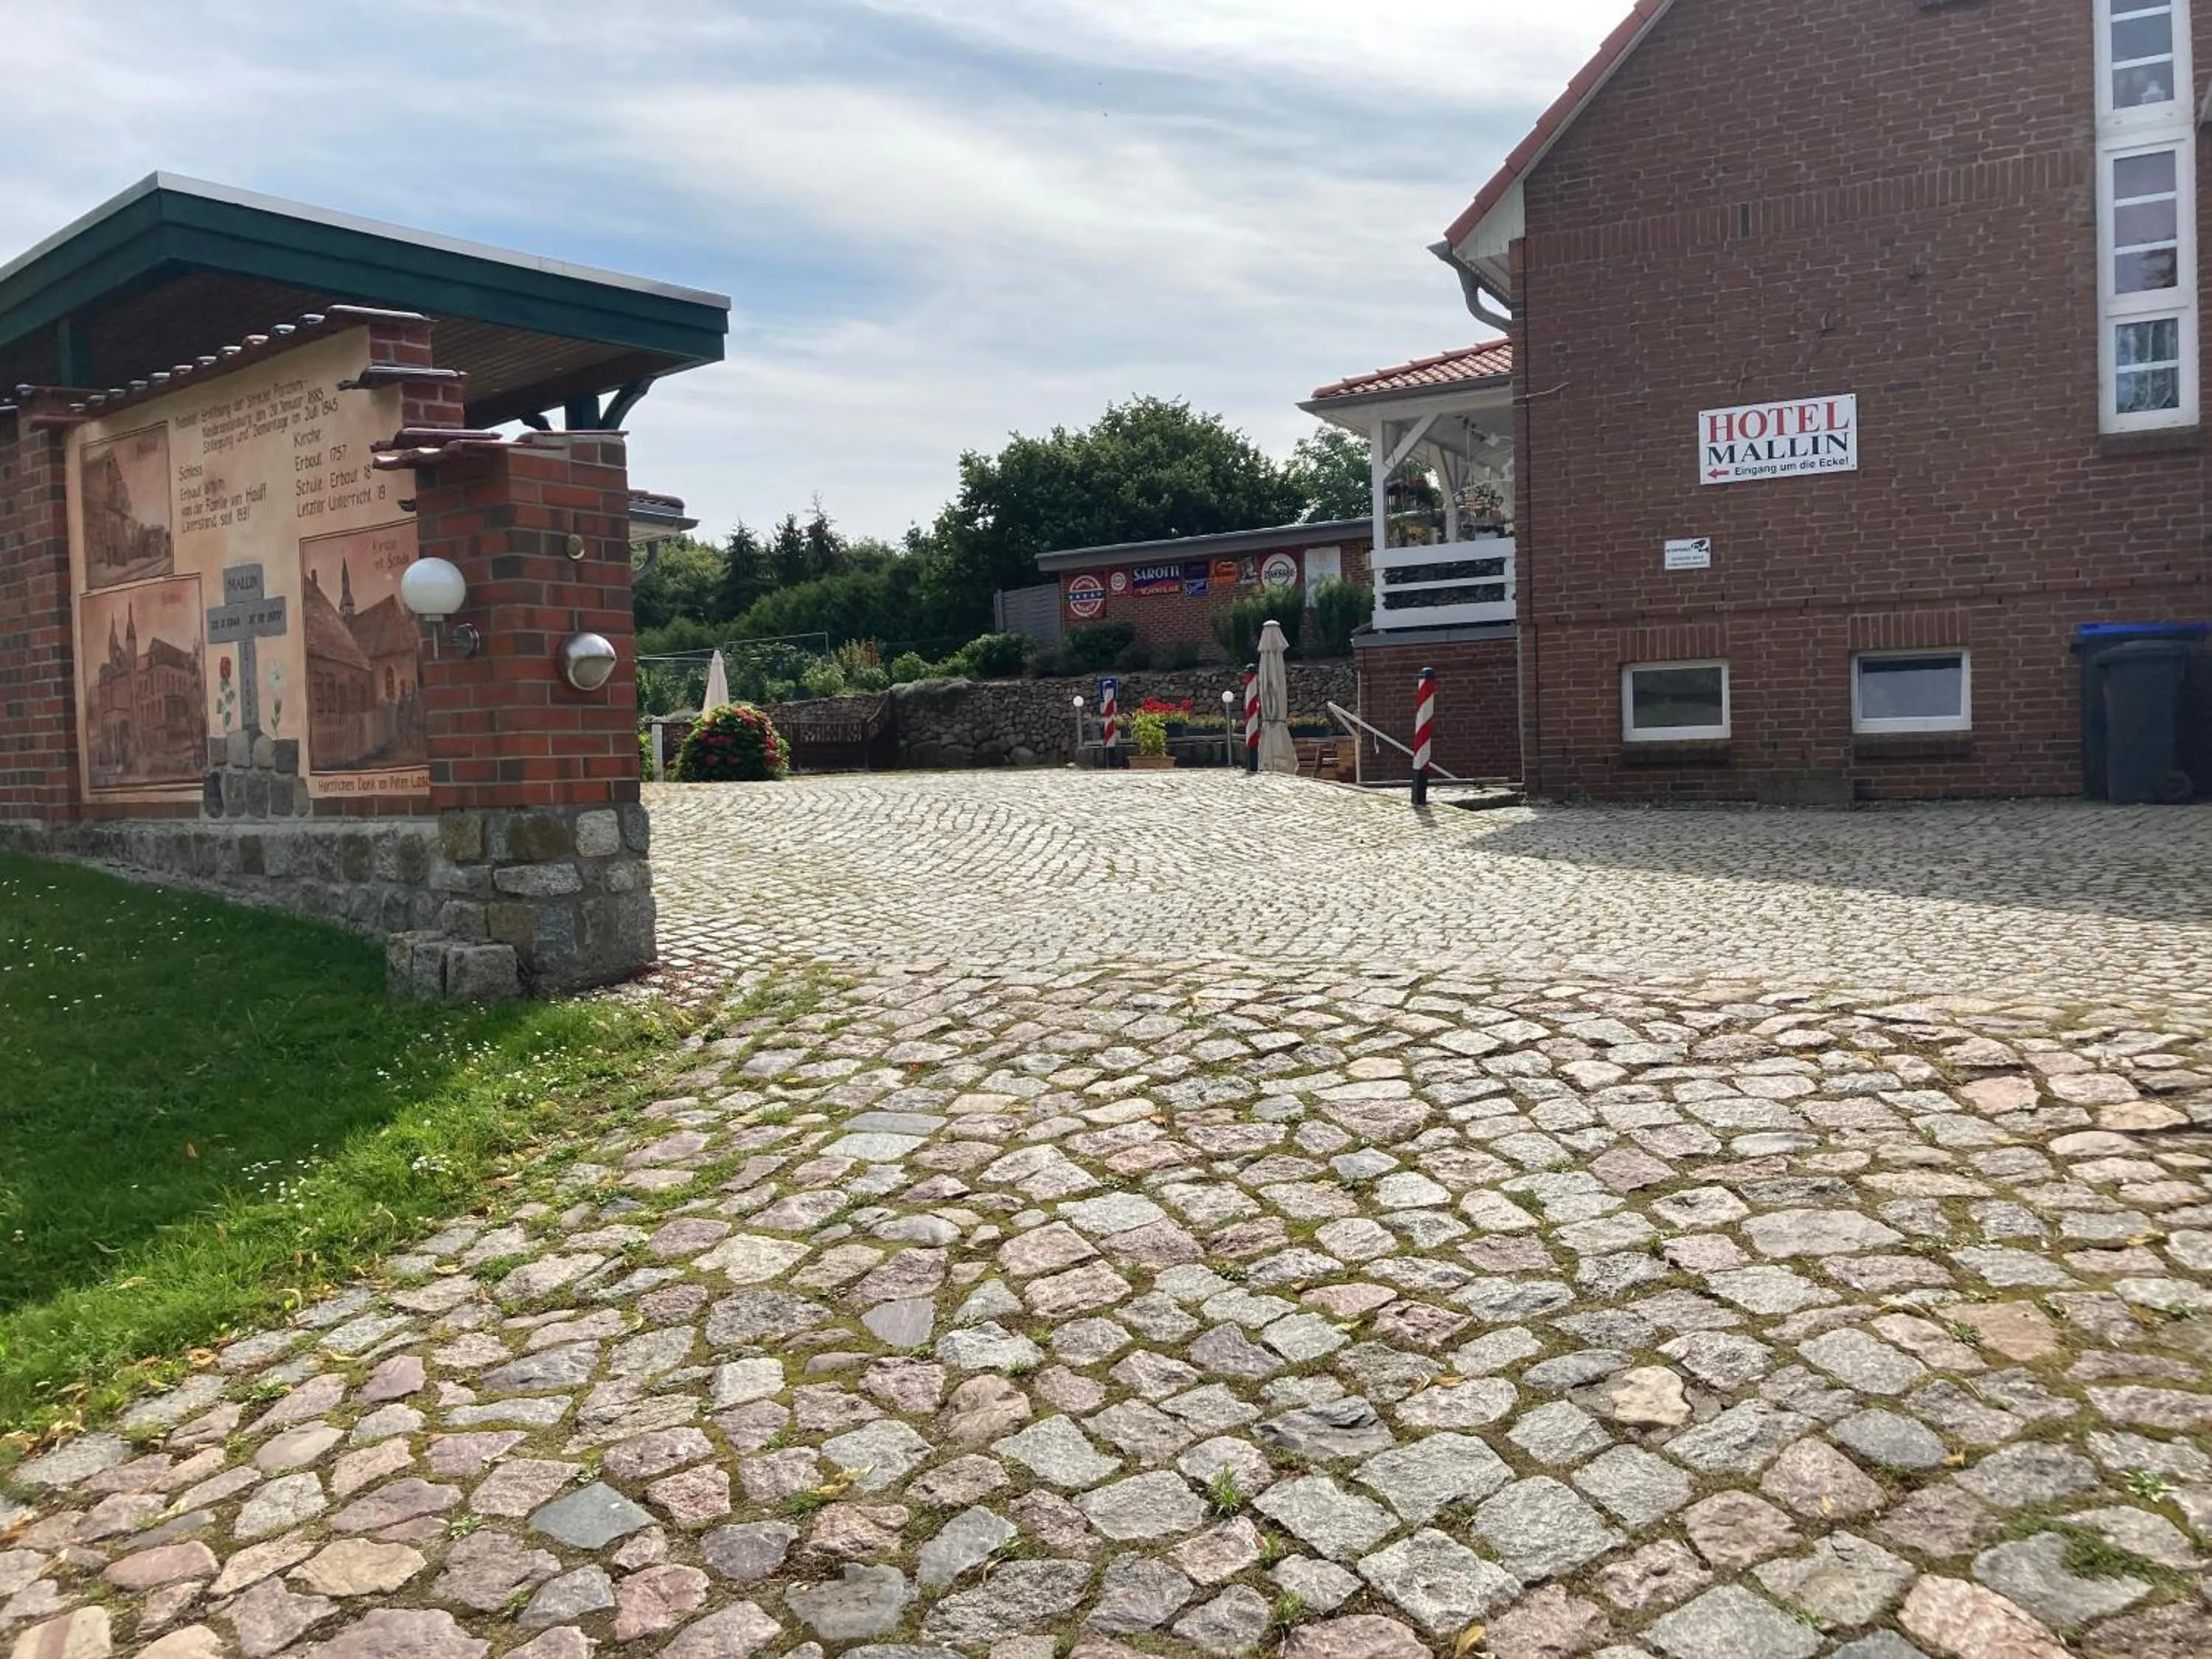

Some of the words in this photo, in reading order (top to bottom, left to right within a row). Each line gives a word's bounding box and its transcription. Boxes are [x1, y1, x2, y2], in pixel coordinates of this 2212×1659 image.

[1706, 401, 1850, 443] HOTEL
[293, 428, 321, 448] Kirche
[1706, 432, 1850, 466] MALLIN
[295, 452, 322, 471] Erbaut
[1735, 465, 1777, 477] Eingang
[1780, 463, 1797, 472] um
[1800, 459, 1815, 470] die
[179, 464, 203, 481] Schloss
[295, 478, 322, 496] Schule
[330, 469, 358, 489] Erbaut
[329, 487, 372, 511] Unterricht
[227, 574, 258, 591] MALLIN
